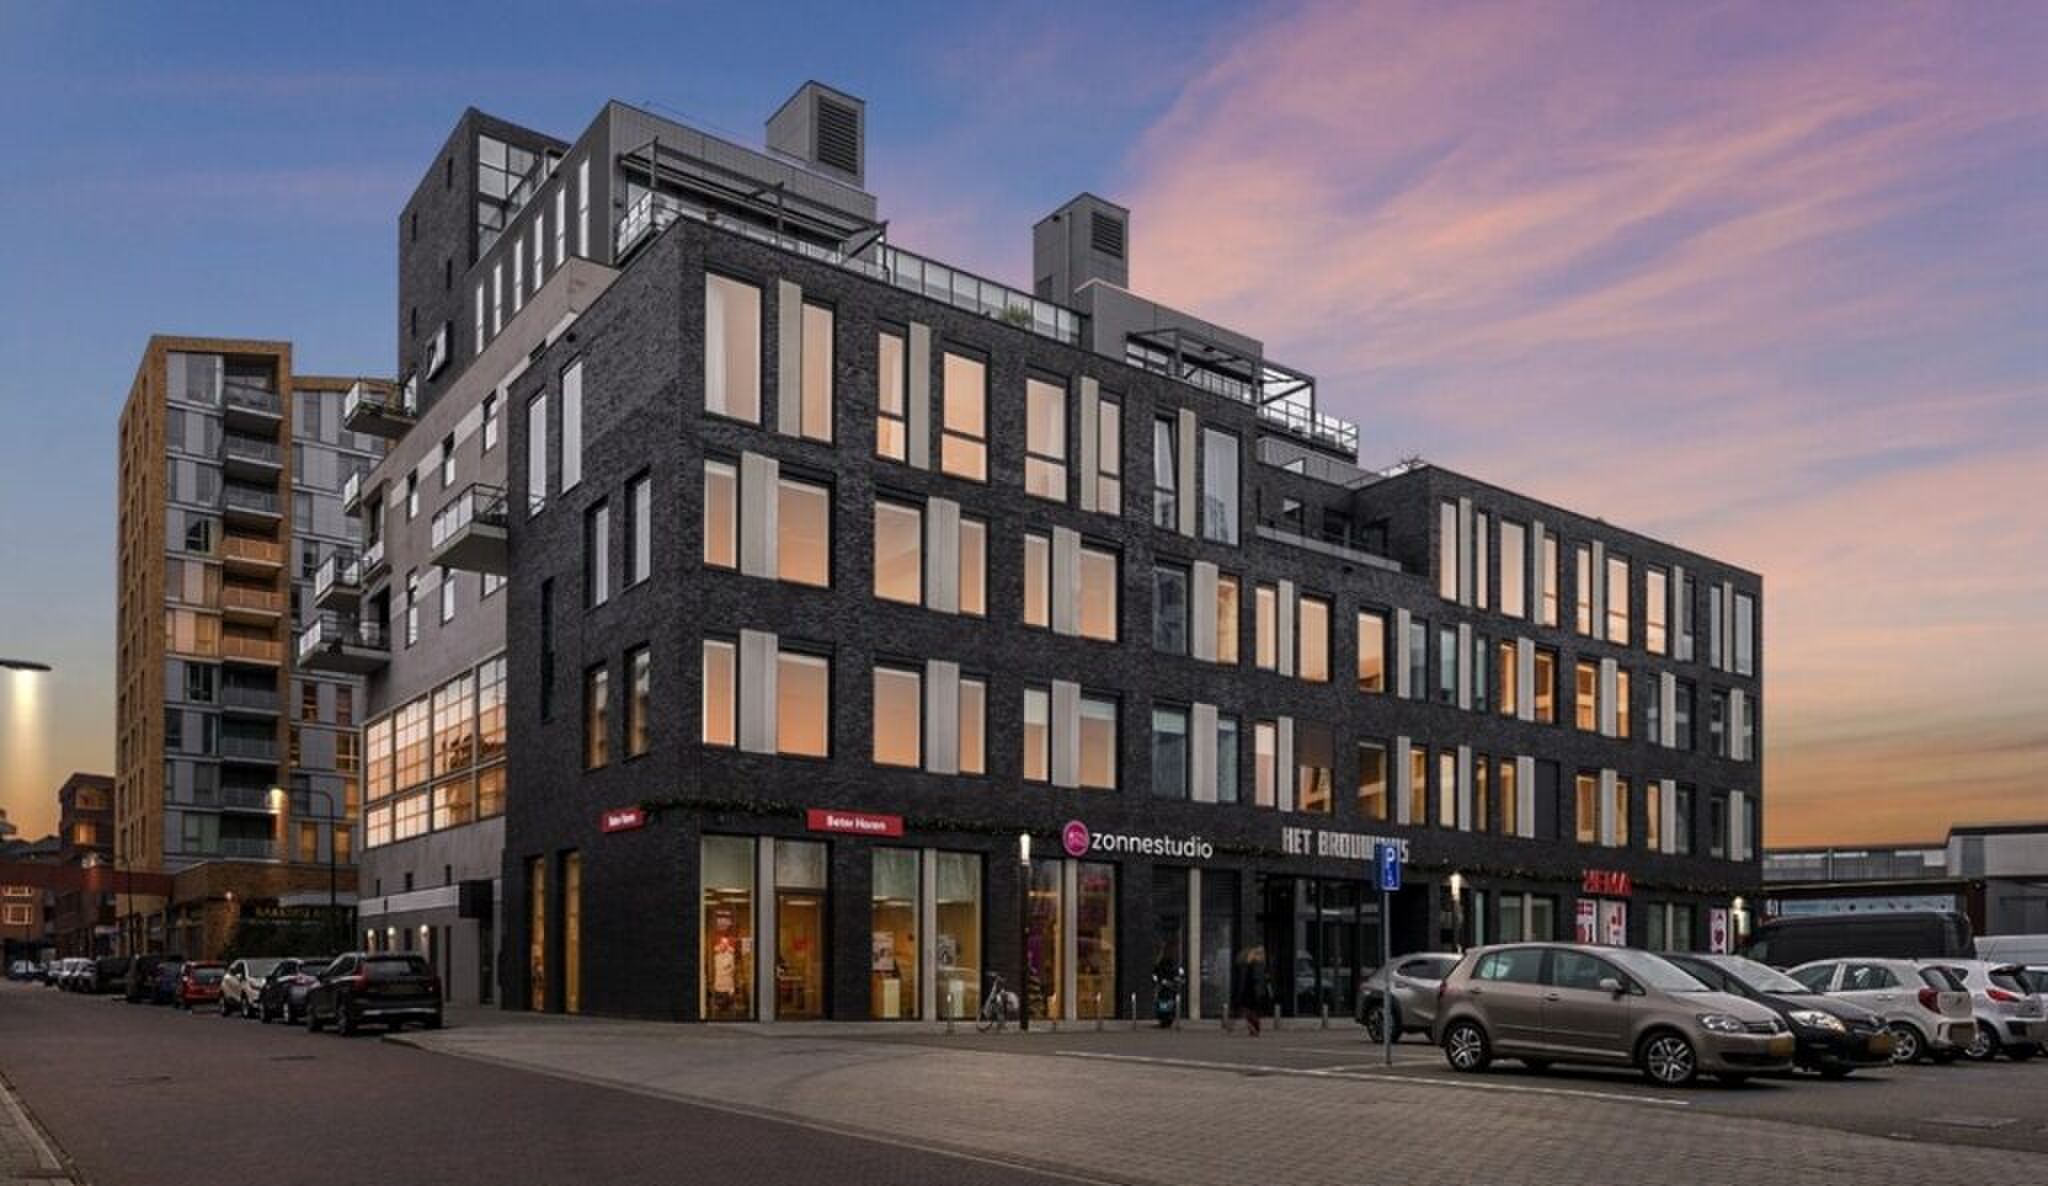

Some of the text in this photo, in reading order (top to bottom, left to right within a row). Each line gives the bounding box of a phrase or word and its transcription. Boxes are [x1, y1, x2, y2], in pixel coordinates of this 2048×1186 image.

[1091, 832, 1214, 859] zonnestudio
[1282, 826, 1409, 863] HET BROUWS
